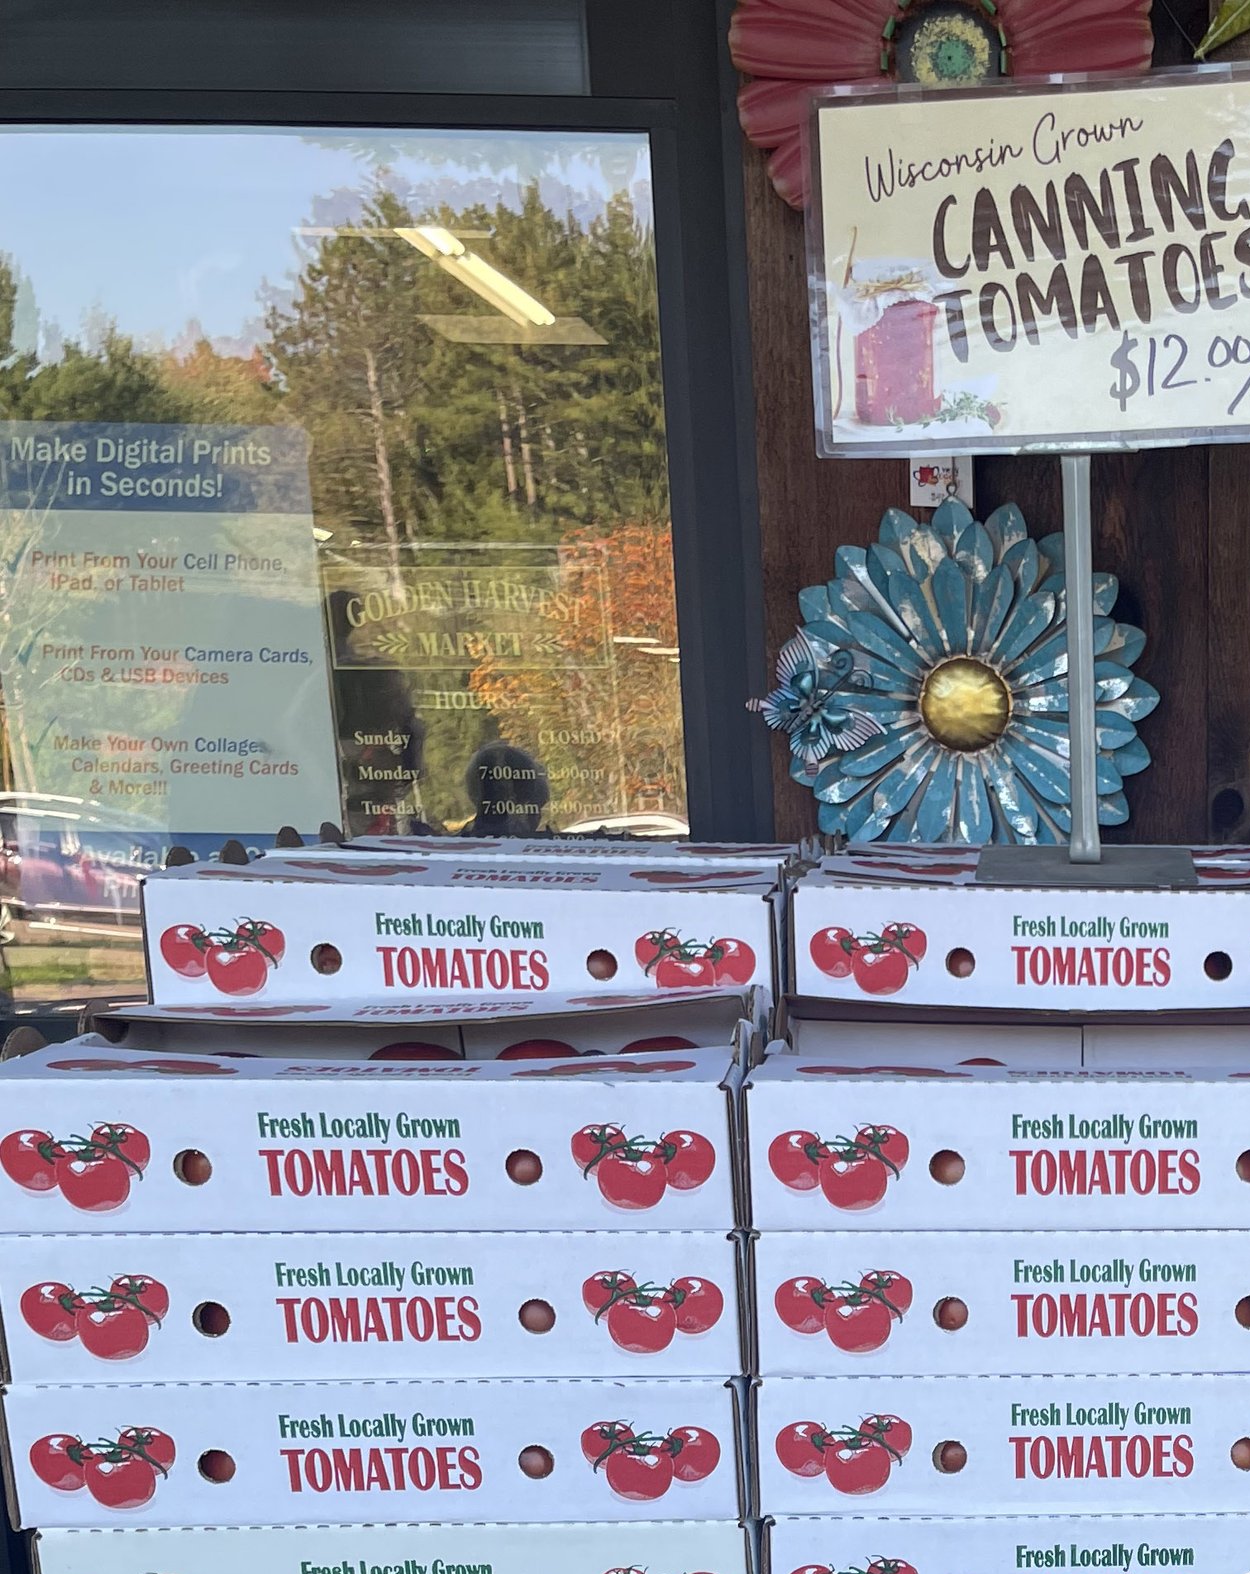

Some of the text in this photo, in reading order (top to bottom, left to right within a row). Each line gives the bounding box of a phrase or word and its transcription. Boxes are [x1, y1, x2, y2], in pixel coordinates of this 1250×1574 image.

[865, 112, 1143, 203] Wisconsin Grown
[933, 138, 1250, 279] CANNING
[10, 437, 272, 468] Make Digital Prints
[67, 472, 224, 498] in Seconds!
[31, 551, 287, 574] Print From Your Cell Phone,
[105, 578, 122, 591] or
[131, 576, 185, 592] Tablet
[347, 580, 588, 628] GOLDEN HARVEST
[43, 644, 313, 666] Print From Your Camera Cards,
[417, 632, 523, 656] MARKET
[61, 667, 229, 683] CDs & USB Devices
[54, 735, 101, 750] Make
[107, 736, 144, 750] Your
[152, 737, 188, 751] Own
[354, 731, 410, 748] Sunday
[72, 758, 298, 778] Calendars, Greeting Cards
[359, 767, 420, 782] Monday
[89, 780, 167, 795] & More!!!
[361, 801, 423, 817] Tuesday
[376, 913, 544, 938] Fresh Locally Grown
[1014, 916, 1168, 942] Fresh Locally Grown
[377, 945, 548, 990] TOMATOES
[1011, 945, 1170, 985] TOMATOES
[258, 1112, 460, 1144] Fresh Locally Grown
[257, 1148, 468, 1195] TOMATOES
[1017, 1543, 1194, 1571] Fresh Locally Grown
